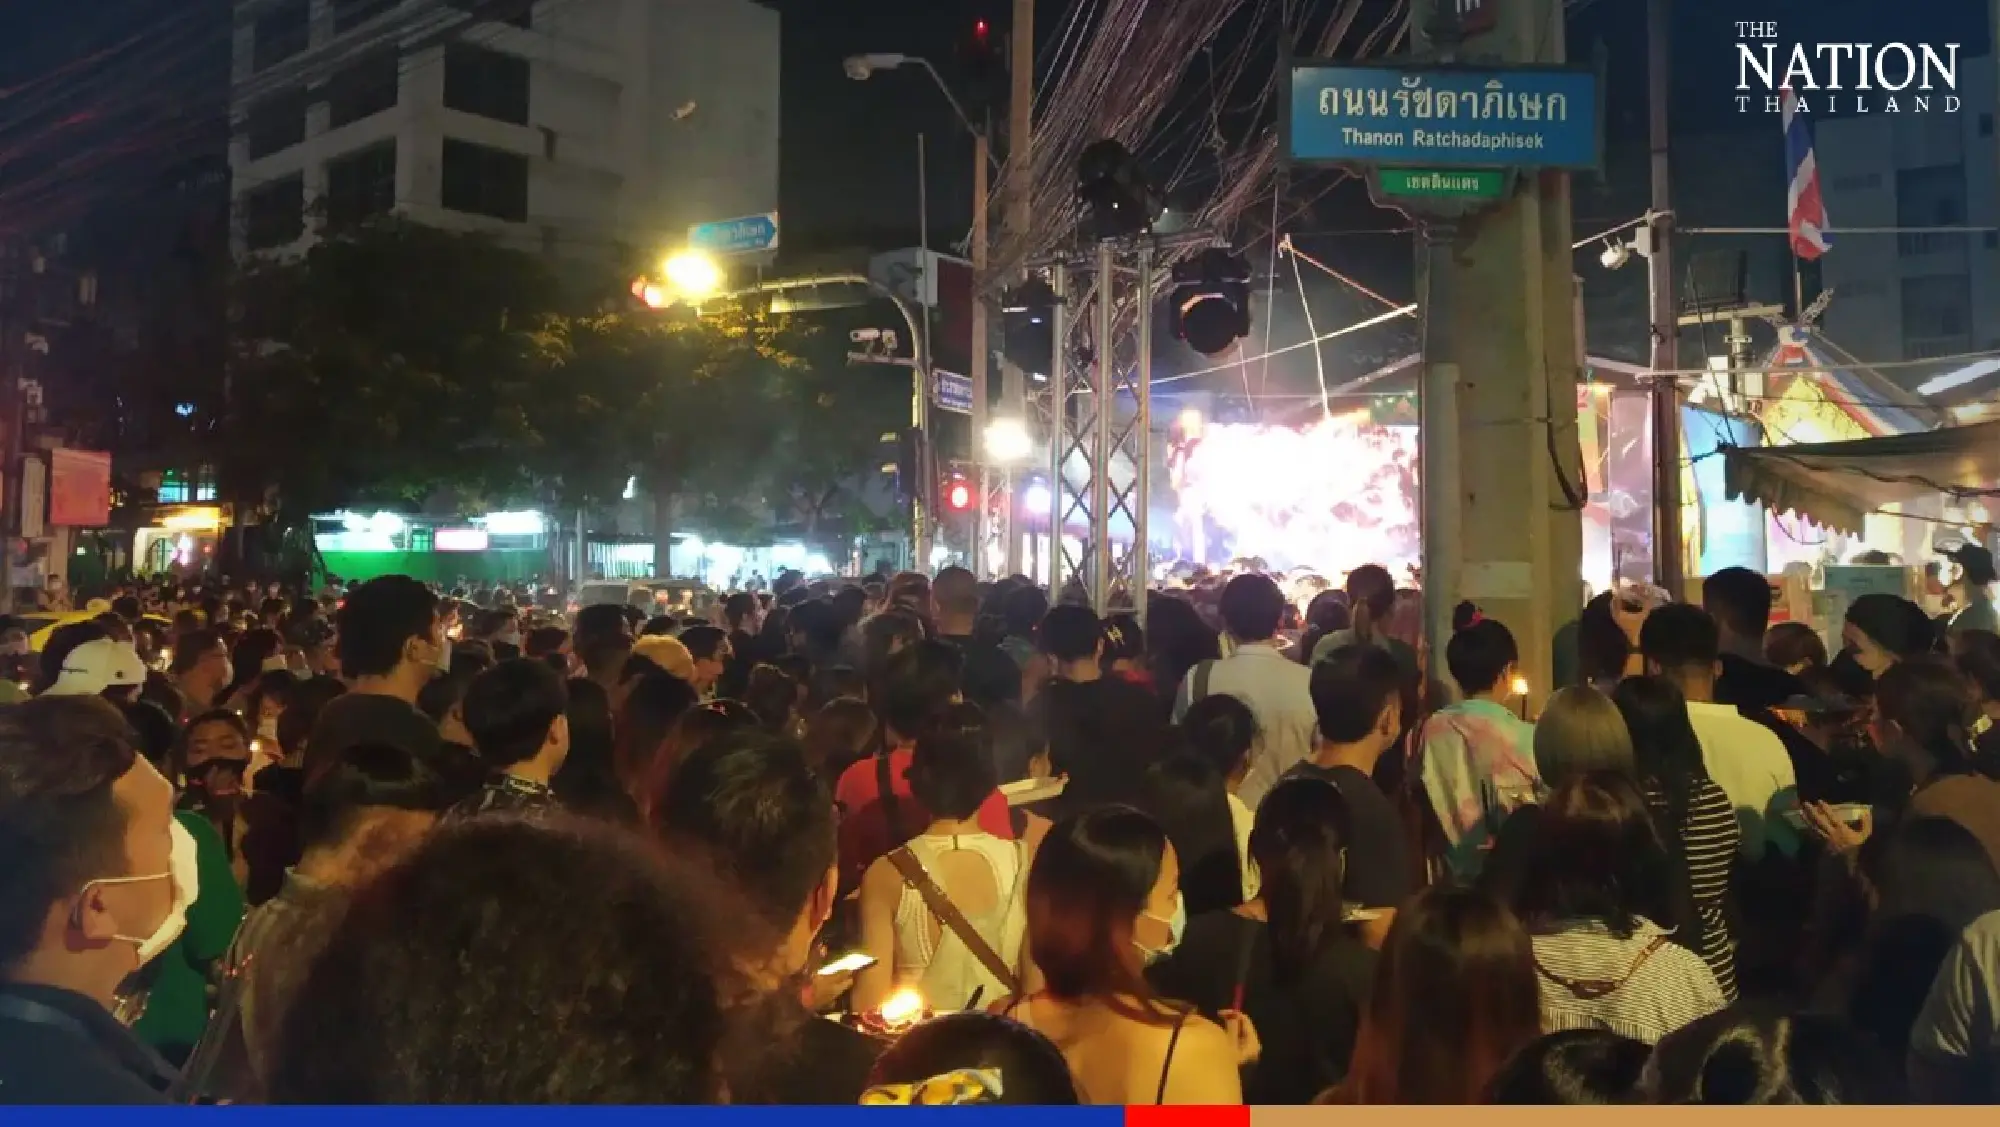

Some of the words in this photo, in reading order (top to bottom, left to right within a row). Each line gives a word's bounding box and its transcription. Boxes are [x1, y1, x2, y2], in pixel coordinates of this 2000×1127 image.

[1319, 76, 1567, 121] ถนนรัชดาภิเษก
[1341, 127, 1404, 147] Thanon
[1412, 129, 1544, 152] Ratchadaphisek
